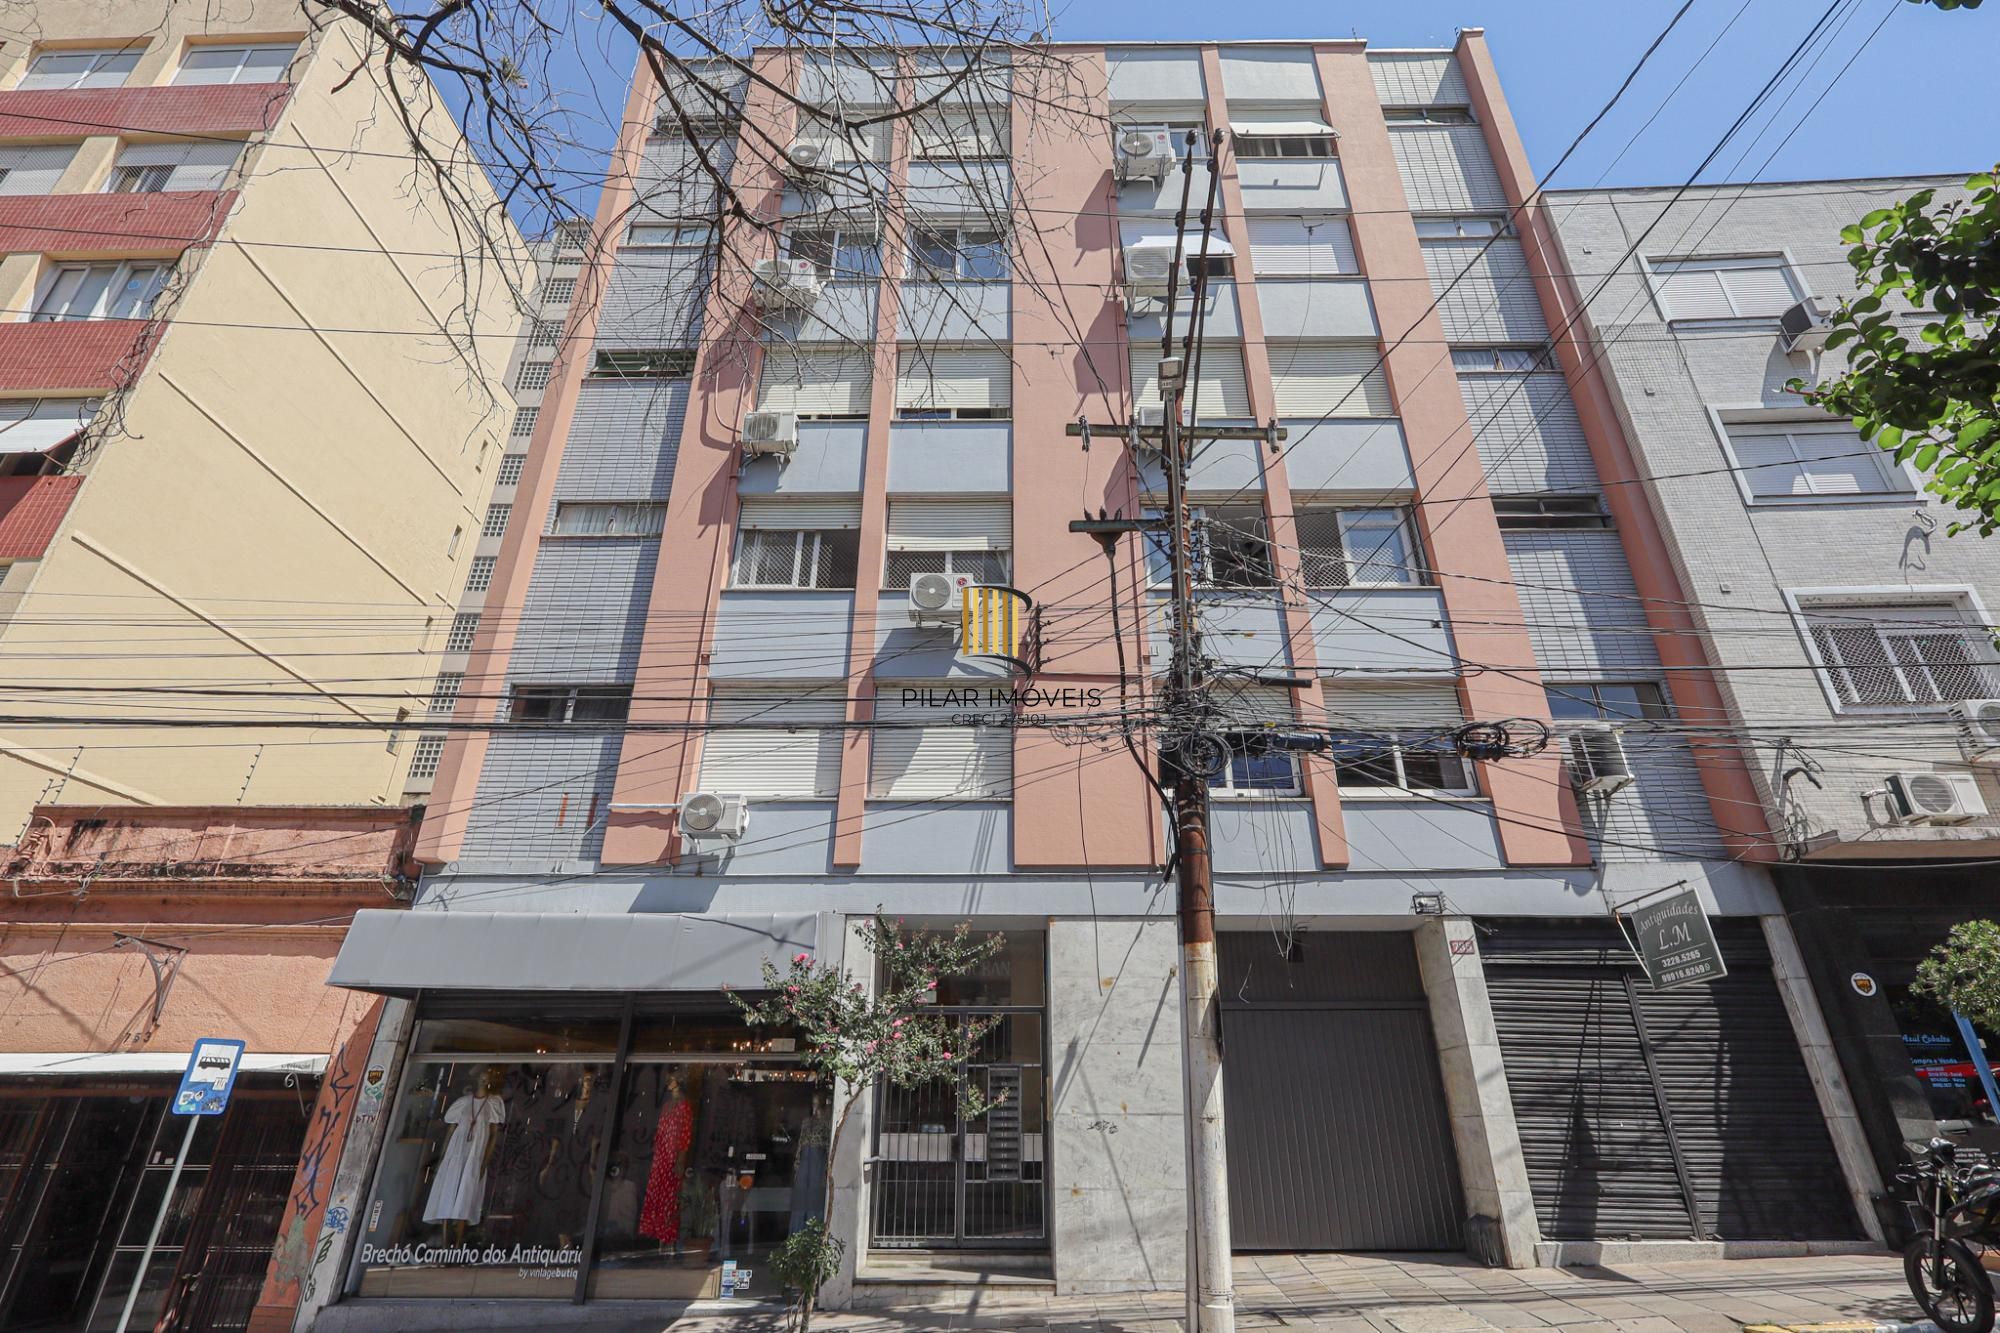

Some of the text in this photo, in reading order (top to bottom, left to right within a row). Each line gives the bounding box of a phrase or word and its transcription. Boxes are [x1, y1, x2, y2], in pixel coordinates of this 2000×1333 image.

[1640, 902, 1697, 934] Antiguidades
[360, 1243, 411, 1263] Brechó
[414, 1243, 479, 1263] Caminho
[482, 1243, 506, 1263] dos
[518, 1267, 528, 1279] by
